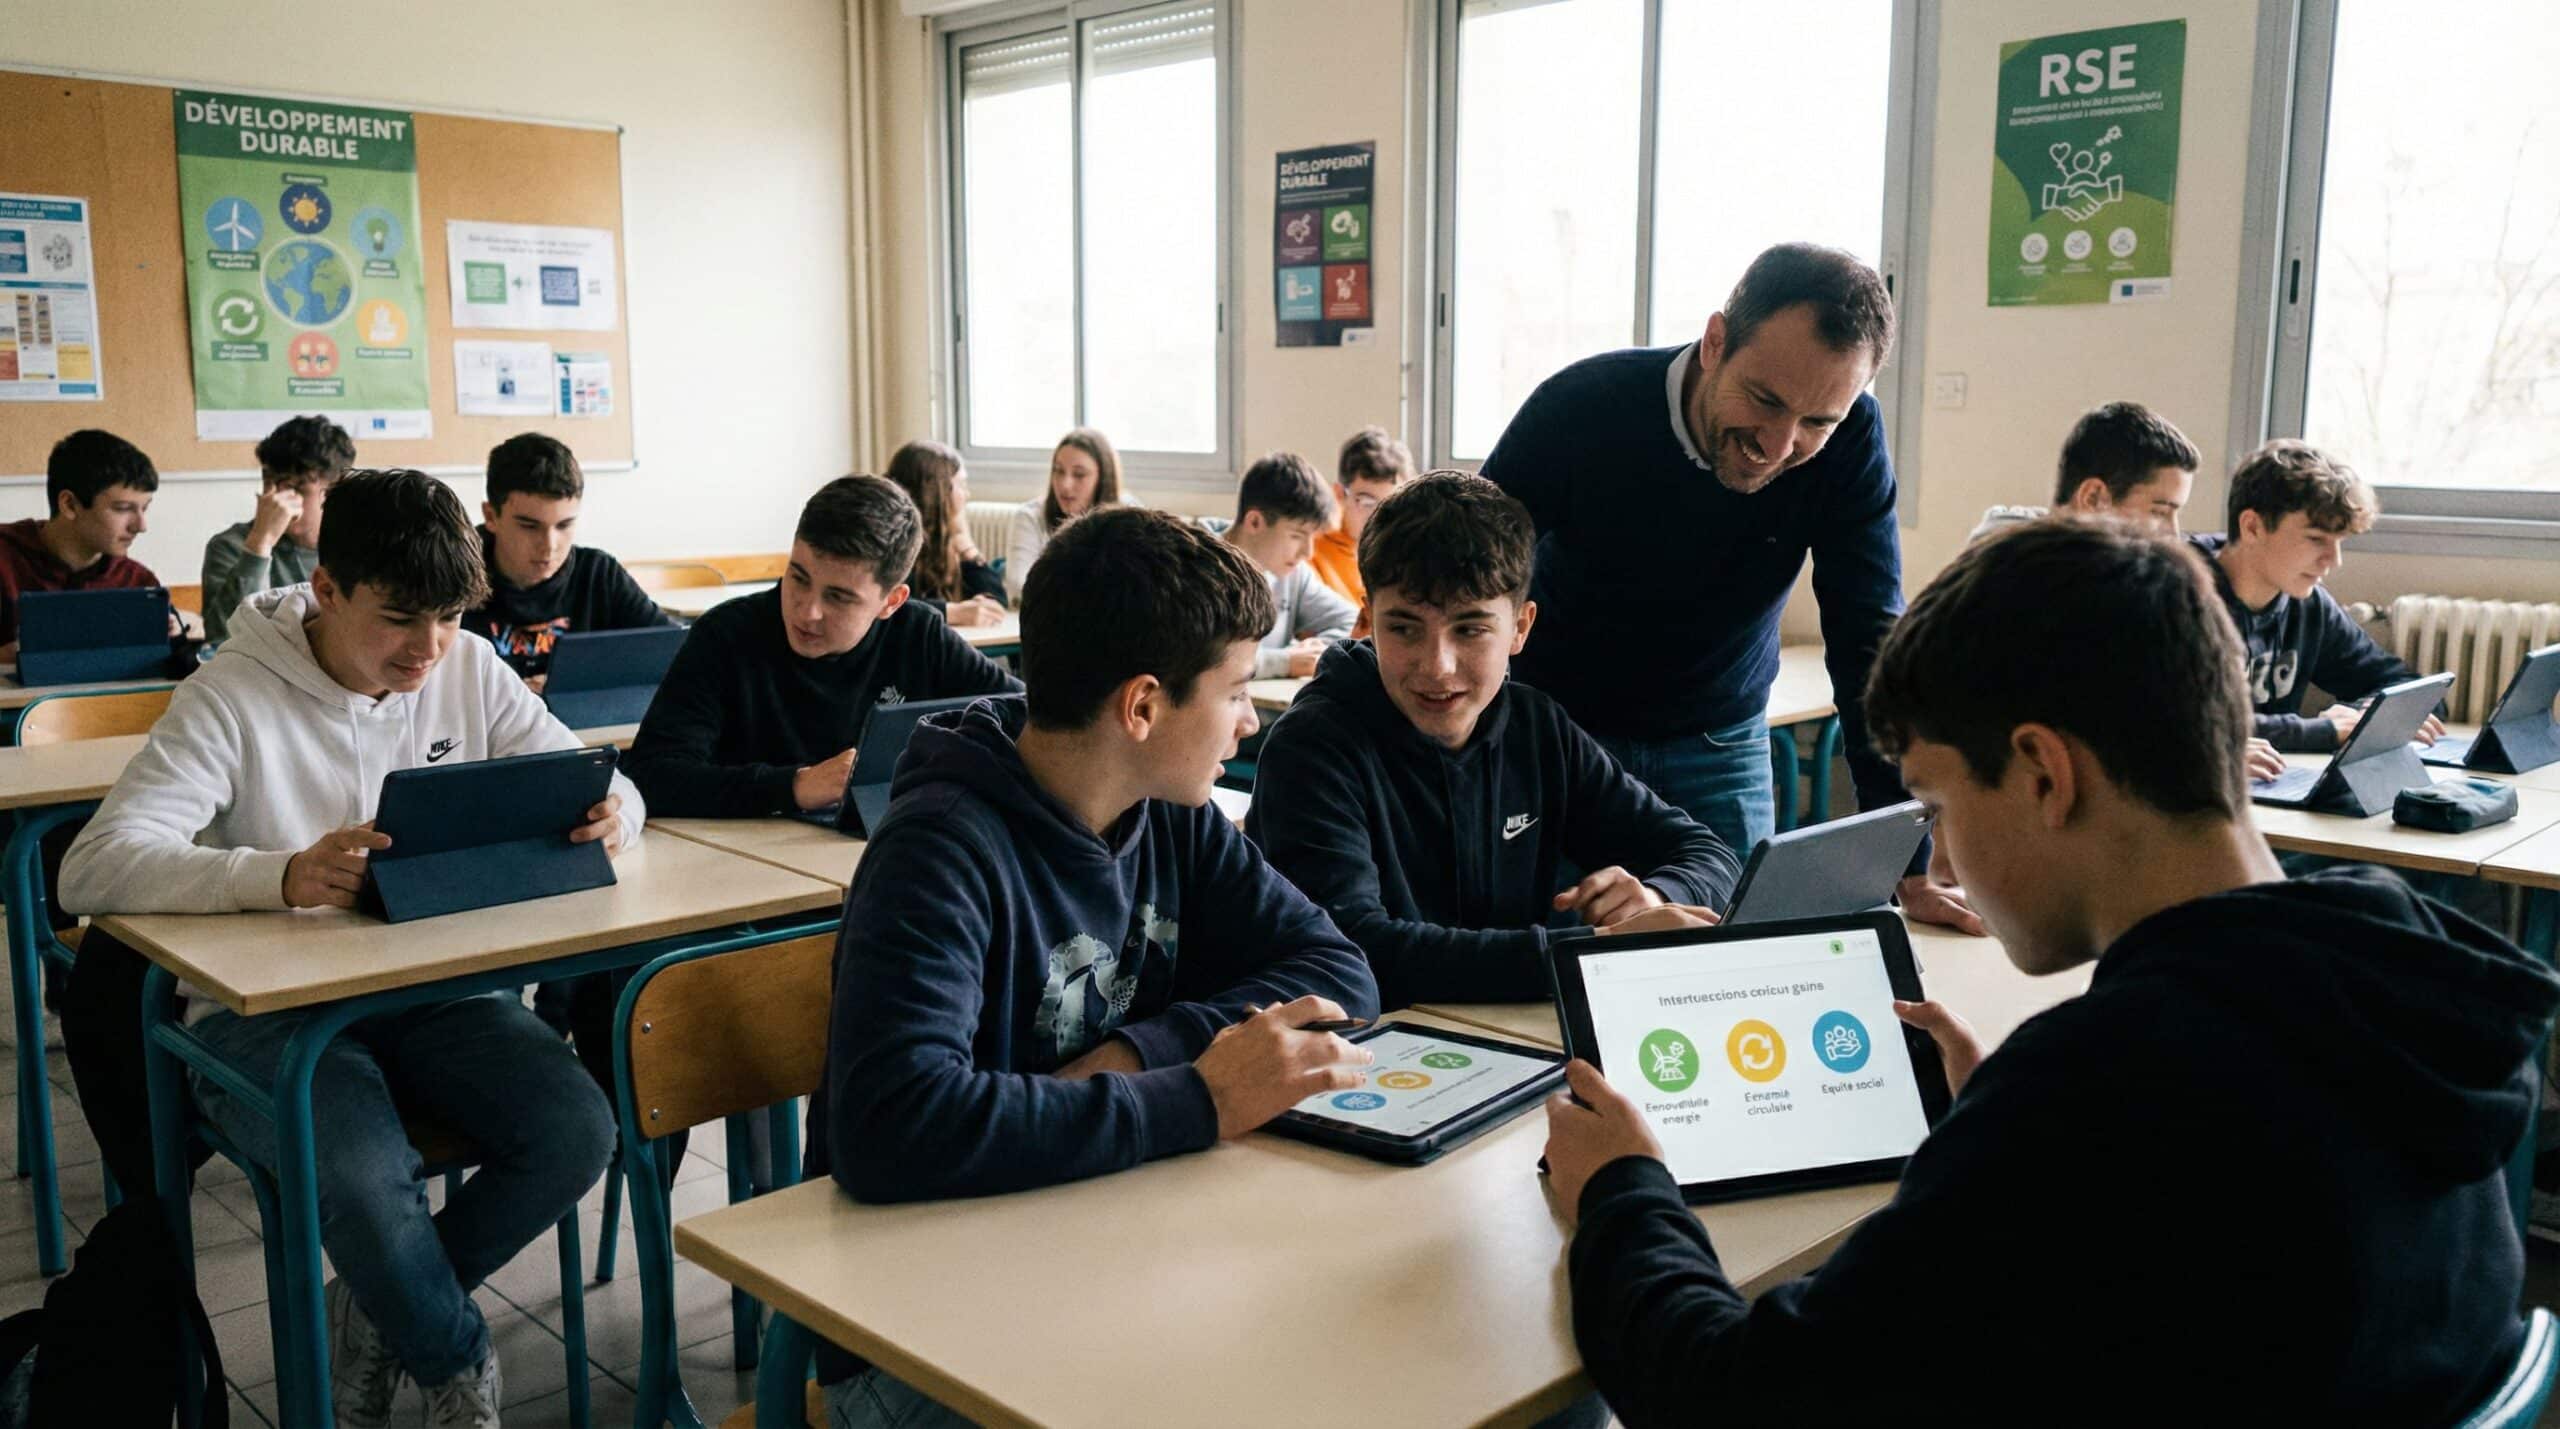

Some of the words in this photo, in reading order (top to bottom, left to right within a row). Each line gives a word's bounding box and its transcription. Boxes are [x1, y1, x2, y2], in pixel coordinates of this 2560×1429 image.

[2039, 44, 2137, 98] RSE
[184, 98, 406, 141] DÉVELOPPEMENT
[240, 131, 359, 160] DURABLE
